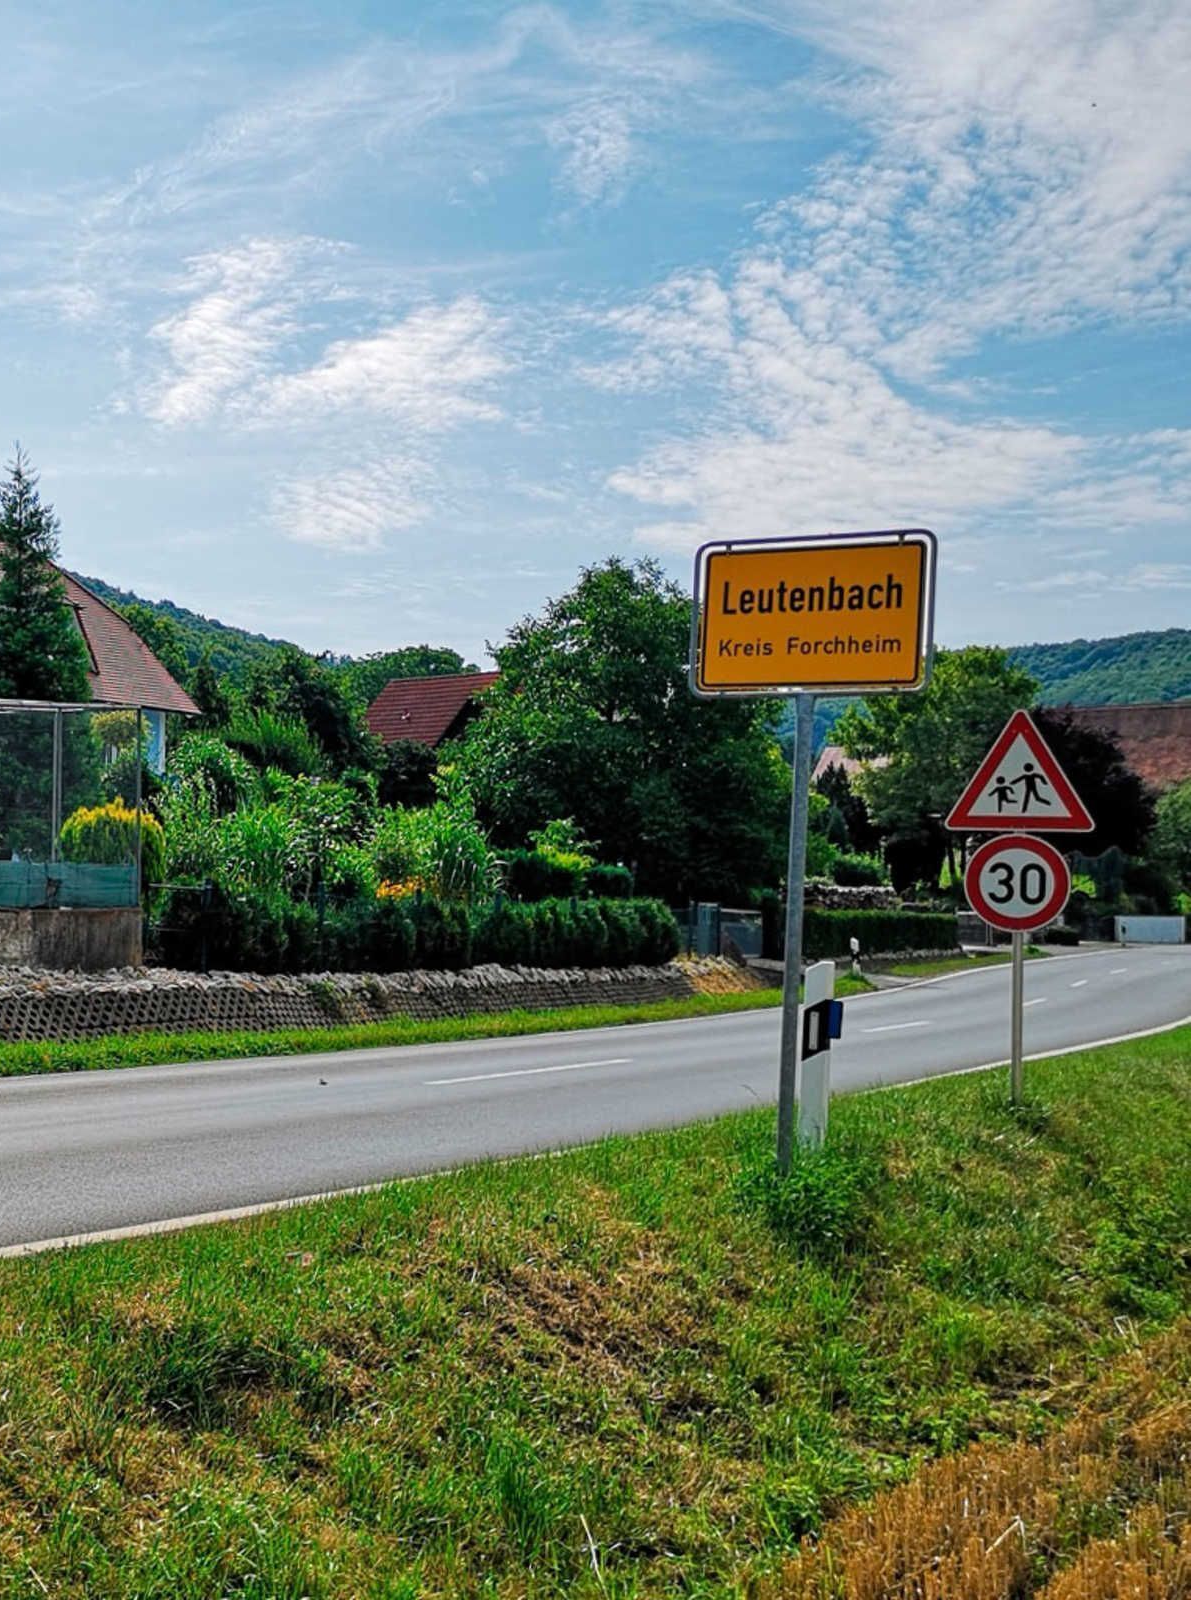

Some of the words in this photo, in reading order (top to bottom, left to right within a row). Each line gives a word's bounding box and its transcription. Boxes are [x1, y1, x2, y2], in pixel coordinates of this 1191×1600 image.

[722, 573, 903, 615] Leutenbach
[719, 639, 773, 657] Kreis
[787, 634, 901, 655] Forchheim
[988, 862, 1047, 905] 30
